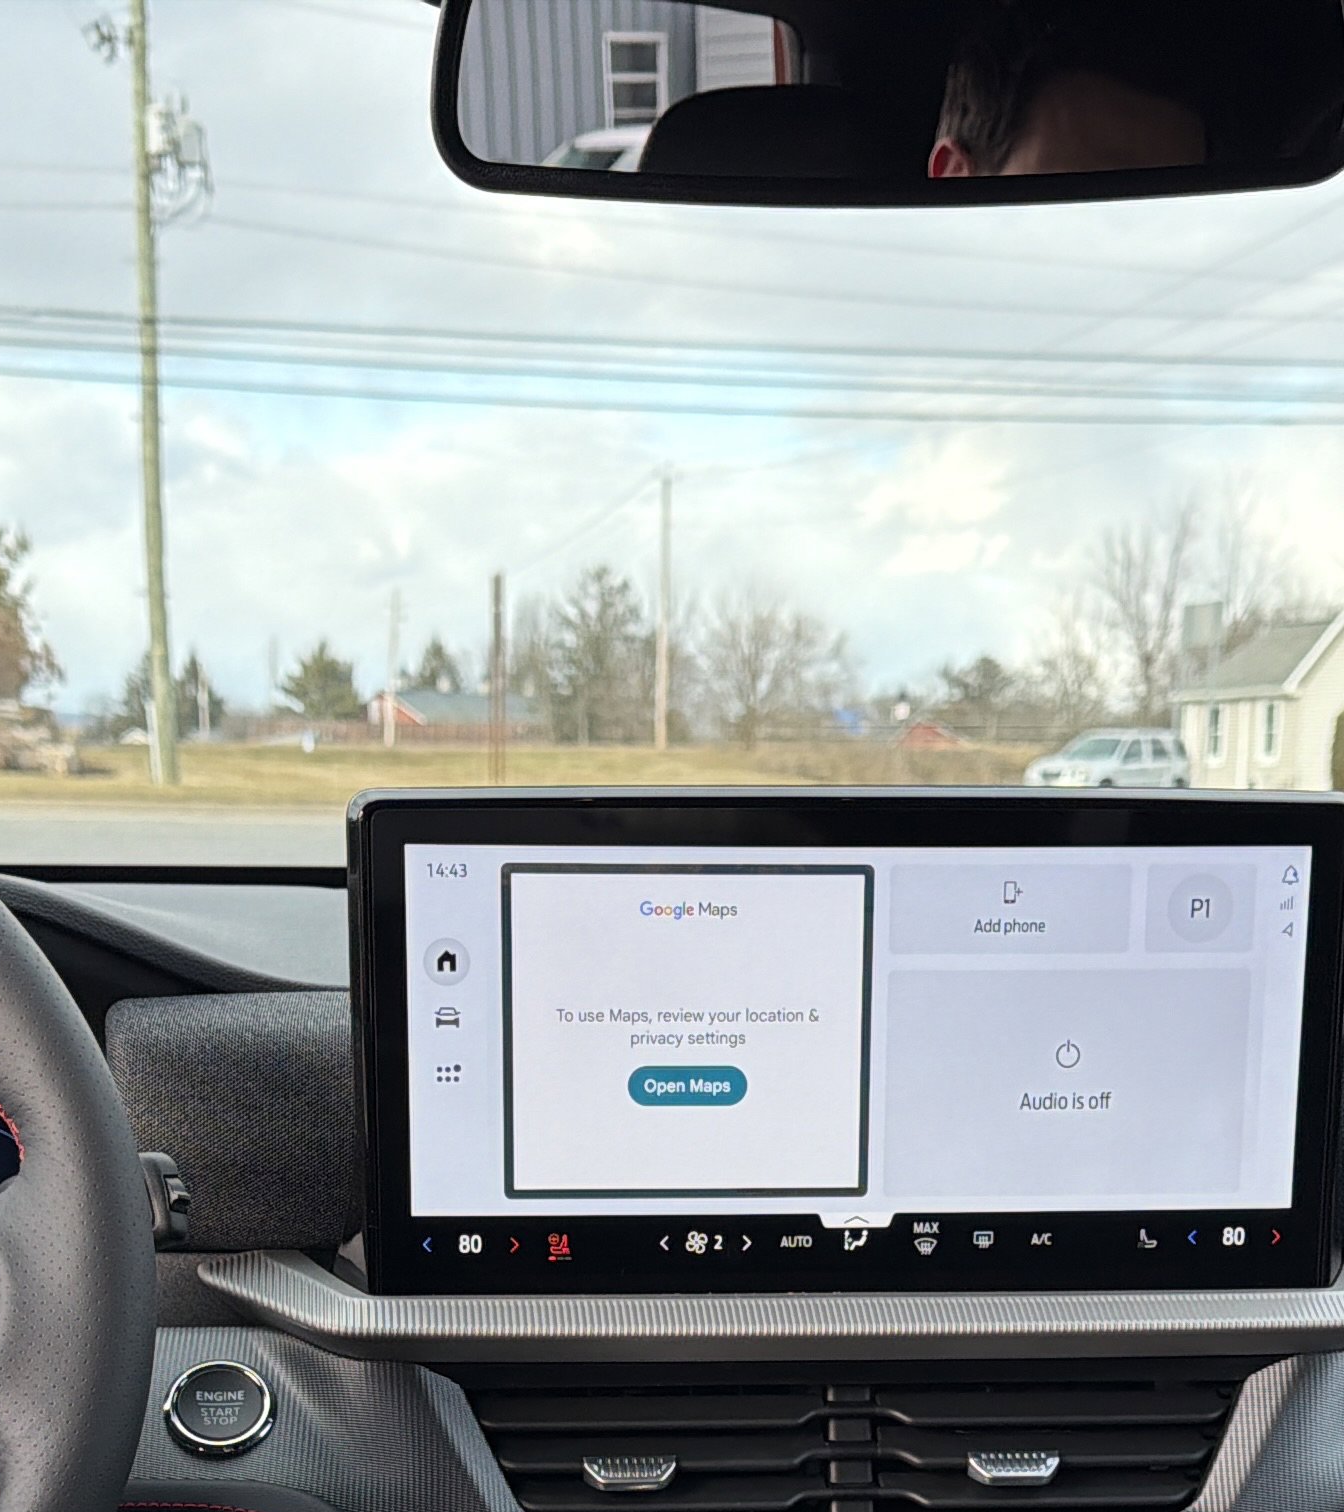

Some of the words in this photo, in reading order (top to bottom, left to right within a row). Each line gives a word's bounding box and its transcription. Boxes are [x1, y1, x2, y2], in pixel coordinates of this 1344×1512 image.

[426, 862, 468, 879] 14:43
[639, 900, 695, 920] Google
[698, 901, 738, 920] Maps
[1190, 898, 1211, 919] P1
[973, 918, 1001, 934] Add
[1003, 918, 1047, 936] phone
[556, 1007, 575, 1023] To
[578, 1011, 605, 1024] use
[609, 1007, 653, 1026] Maps,
[656, 1008, 705, 1024] review
[708, 1011, 742, 1027] your
[745, 1007, 804, 1024] location
[808, 1008, 820, 1023] &
[629, 1031, 684, 1049] privacy
[687, 1029, 746, 1048] settings
[643, 1078, 686, 1097] Open
[689, 1078, 732, 1097] Maps
[1019, 1092, 1068, 1111] Audio
[1072, 1092, 1085, 1110] is
[1087, 1091, 1112, 1110] off
[912, 1221, 940, 1234] MAX
[1221, 1226, 1246, 1247] 80
[458, 1233, 483, 1255] 80
[712, 1234, 724, 1251] 2
[779, 1235, 813, 1249] AUTO
[1030, 1231, 1053, 1246] A/C
[195, 1390, 246, 1401] ENGINE
[200, 1406, 241, 1417] START
[203, 1416, 238, 1426] STOP
